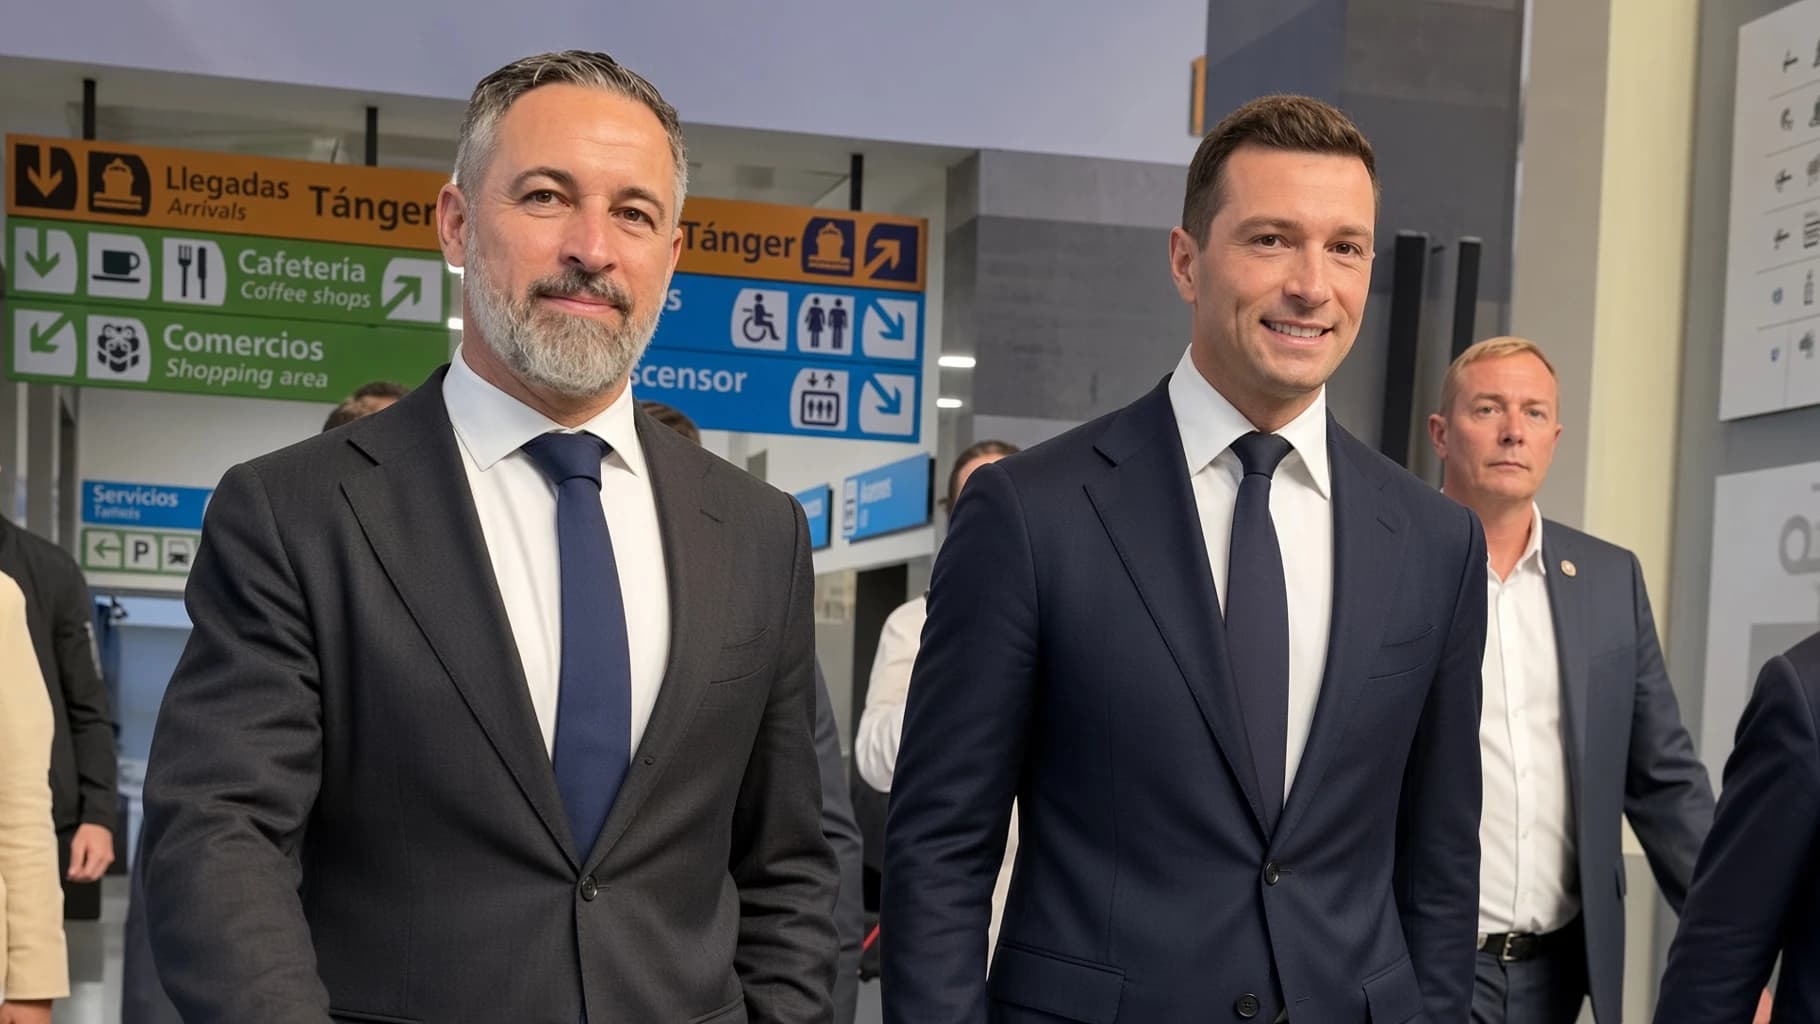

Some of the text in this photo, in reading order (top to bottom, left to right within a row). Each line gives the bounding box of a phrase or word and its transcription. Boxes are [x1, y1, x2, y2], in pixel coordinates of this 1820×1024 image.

[166, 166, 289, 200] Llegadas
[167, 200, 246, 221] Arrivals
[309, 186, 437, 231] Tánger
[680, 220, 796, 263] Tánger
[238, 249, 366, 283] Cafetería
[240, 281, 370, 310] Coffee shops
[163, 323, 324, 361] Comercios
[166, 358, 328, 389] Shopping area
[630, 363, 748, 393] scensor
[93, 484, 179, 508] Servicios
[133, 539, 149, 563] P
